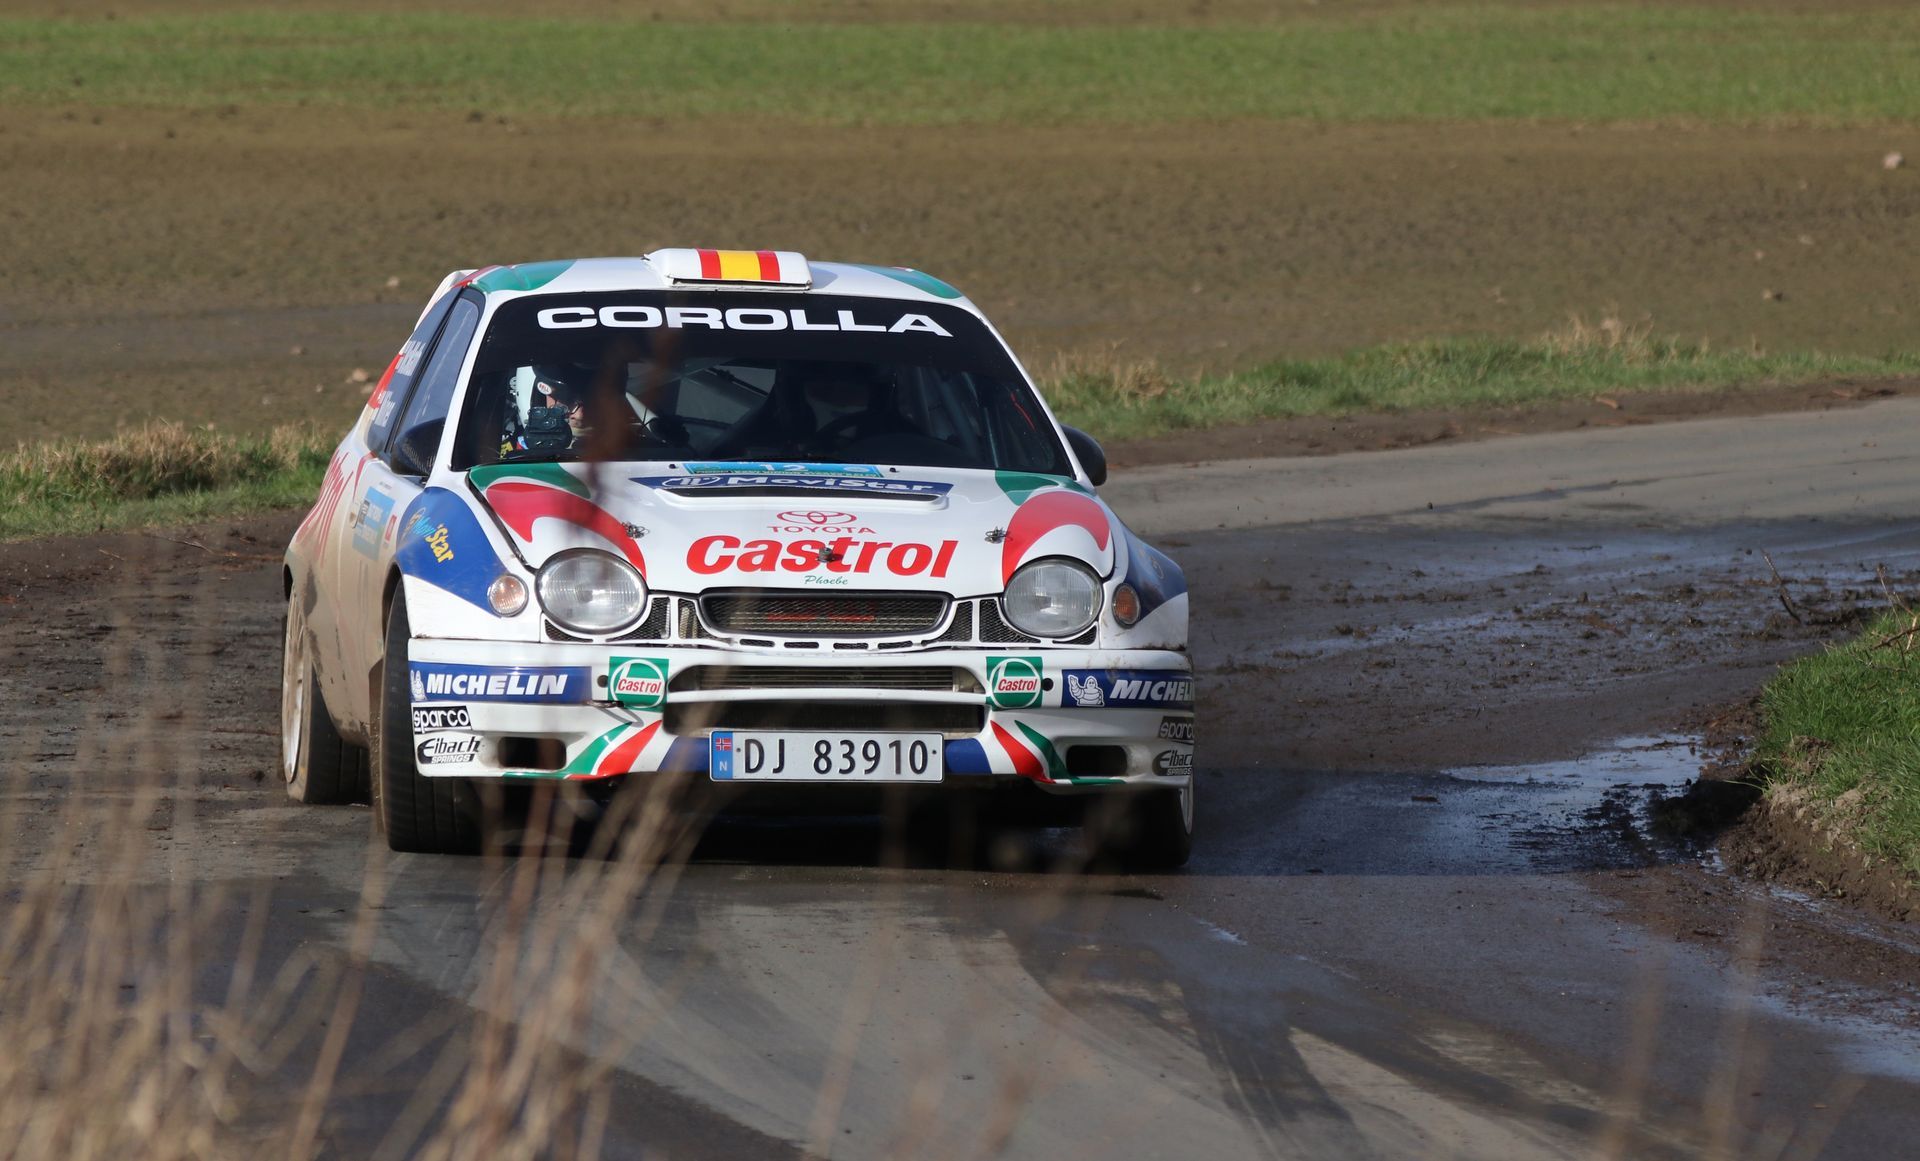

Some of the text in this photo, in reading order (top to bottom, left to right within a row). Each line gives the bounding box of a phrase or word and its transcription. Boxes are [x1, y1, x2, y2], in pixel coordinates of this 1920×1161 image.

[537, 306, 953, 337] COROLLA
[727, 476, 933, 492] MoviStar
[768, 526, 877, 534] TOYOTA
[686, 535, 958, 578] Castrol
[804, 575, 849, 585] Phoebe
[427, 674, 568, 695] MICHELIN
[617, 677, 662, 693] Castrol
[997, 678, 1038, 692] Castrol
[413, 708, 469, 732] sparco
[417, 736, 480, 763] Eibach
[744, 739, 928, 775] DJ 83910
[431, 754, 471, 764] SPRINGS
[719, 761, 728, 771] N
